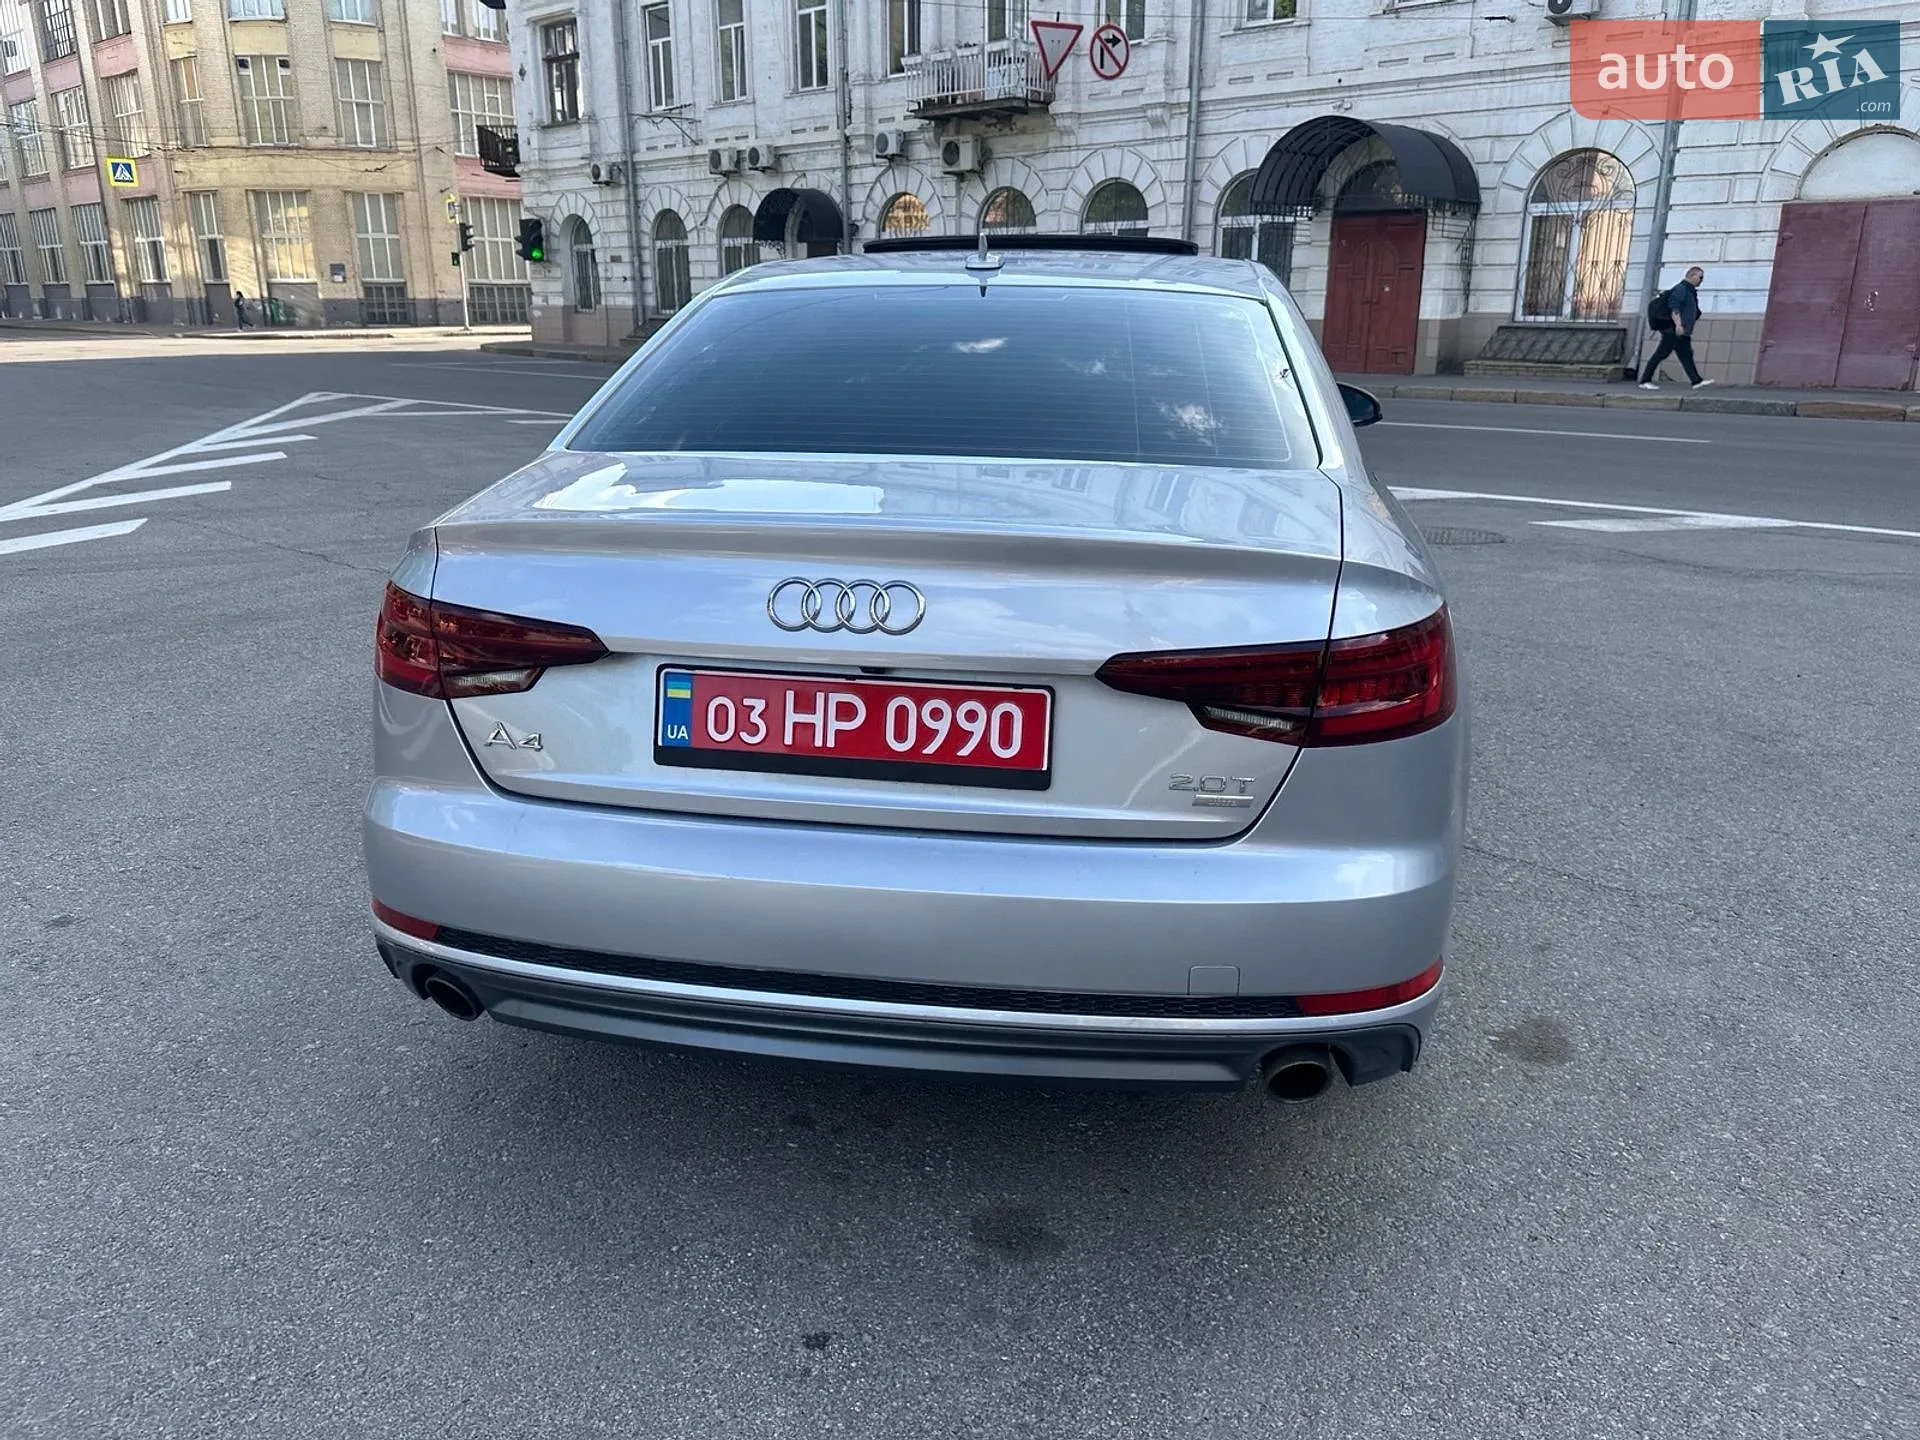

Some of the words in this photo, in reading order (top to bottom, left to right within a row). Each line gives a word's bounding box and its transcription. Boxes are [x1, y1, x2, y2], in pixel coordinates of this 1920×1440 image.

[485, 722, 543, 751] A4
[667, 725, 688, 741] UA
[706, 695, 767, 744] 03
[783, 690, 867, 748] HP
[885, 695, 1023, 759] 0990
